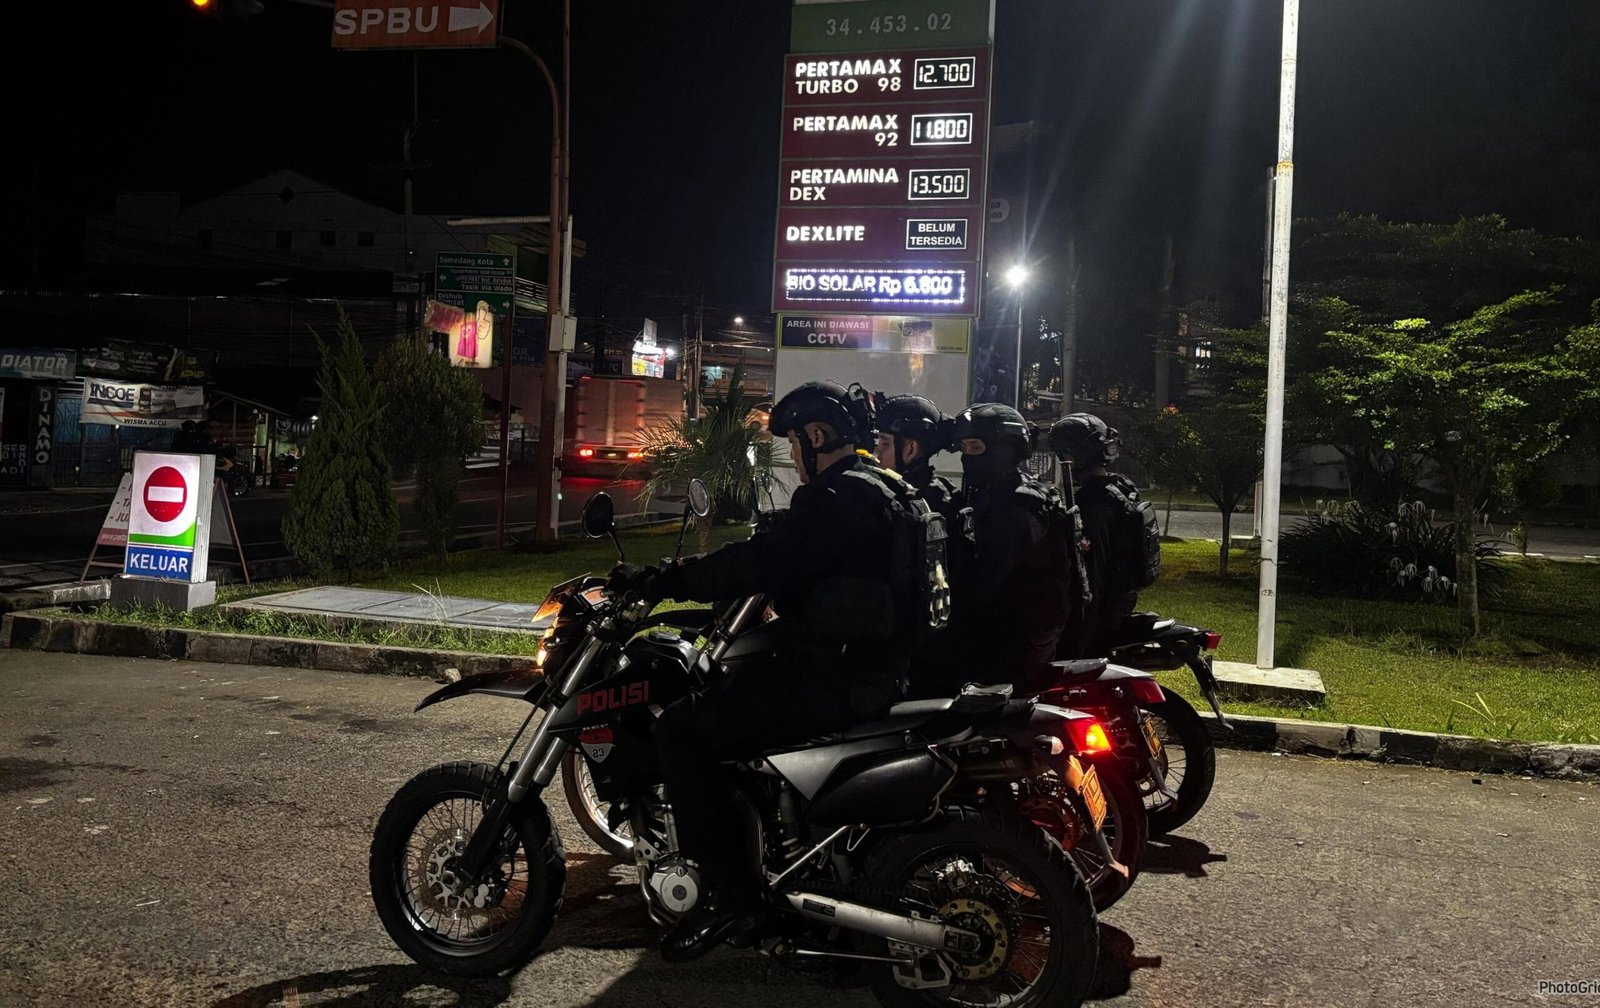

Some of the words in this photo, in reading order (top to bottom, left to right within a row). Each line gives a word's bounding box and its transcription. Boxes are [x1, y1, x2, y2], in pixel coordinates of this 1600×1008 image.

[334, 6, 439, 35] SPBU
[826, 13, 952, 36] 34.453.02
[795, 58, 902, 77] PERTAMAX
[919, 63, 970, 83] 12.700
[796, 78, 859, 94] TURBO
[877, 76, 901, 92] 98
[793, 114, 898, 131] PERTAMAX
[915, 119, 968, 139] 11.800
[874, 132, 898, 146] 92
[790, 168, 899, 184] PERTAMINA
[913, 175, 964, 194] 13.500
[790, 186, 826, 201] DEX
[786, 225, 865, 242] DEXLITE
[918, 223, 955, 233] BELUM
[910, 236, 962, 246] TERSEDIA
[440, 256, 475, 267] Sumedang
[787, 275, 816, 290] BIO
[878, 276, 901, 297] Rp
[786, 320, 812, 328] AREA
[814, 320, 827, 328] INI
[829, 321, 869, 329] DIAWASI
[807, 333, 847, 345] CCTV
[91, 384, 135, 401] INCOE
[35, 389, 51, 464] DINAMO
[130, 553, 188, 573] KELUAR
[576, 680, 650, 716] POLISI
